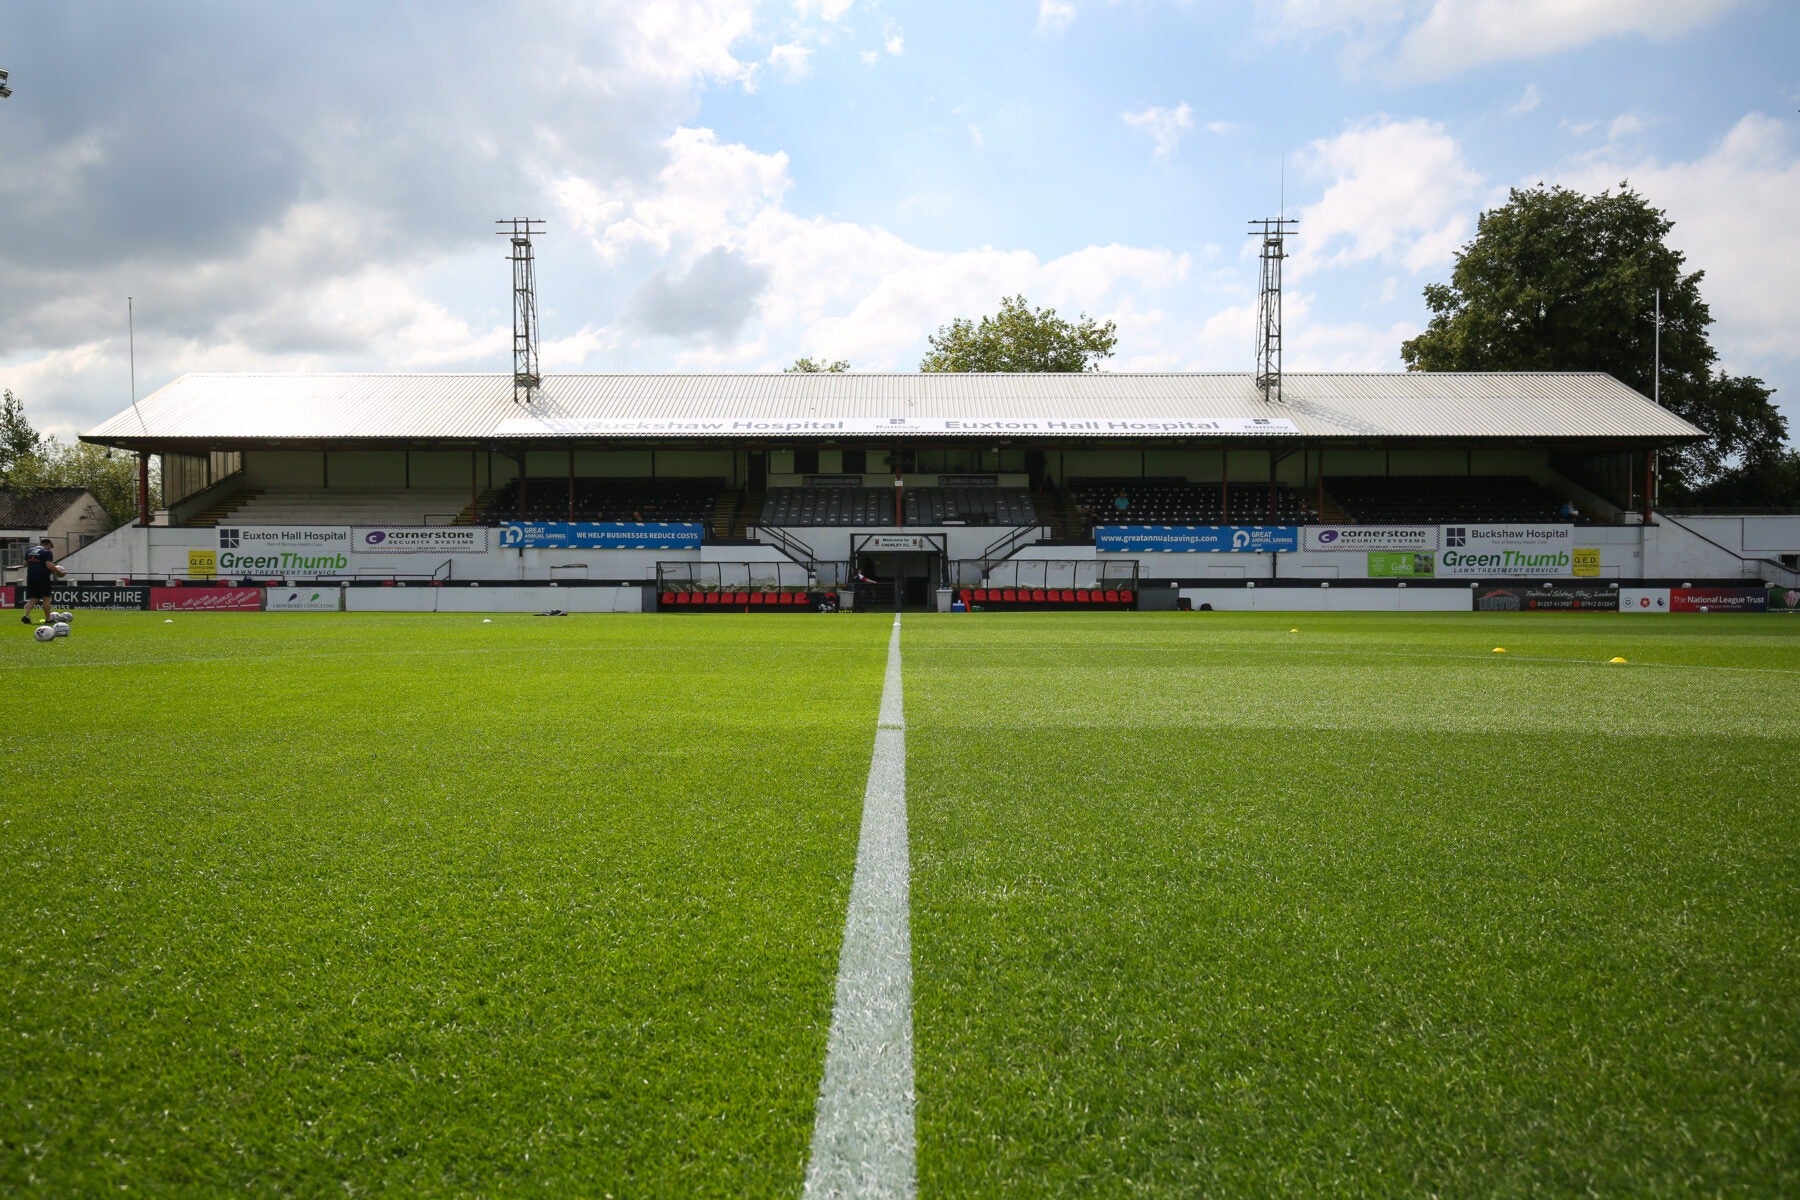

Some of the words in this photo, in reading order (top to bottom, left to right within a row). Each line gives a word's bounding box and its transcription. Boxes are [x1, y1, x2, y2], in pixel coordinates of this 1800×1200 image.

[584, 421, 723, 430] Buckshaw
[732, 421, 844, 431] Hospital
[945, 421, 1038, 429] Euxton
[1047, 421, 1099, 429] Hall
[1107, 421, 1220, 431] Hospital
[242, 531, 279, 540] Euxton
[281, 531, 301, 540] Hall
[304, 531, 347, 542] Hospital
[388, 531, 474, 539] cornerstone
[676, 532, 699, 540] COSTS
[1101, 533, 1218, 543] www.greatannualsavings.com
[1341, 529, 1426, 537] cornerstone
[1471, 529, 1524, 538] Buckshaw
[1526, 529, 1568, 540] Hospital
[219, 552, 348, 569] GreenThumb
[1443, 550, 1569, 567] GreenThumb
[81, 591, 111, 602] SKIP
[113, 591, 142, 602] HIRE
[1687, 596, 1718, 604] National
[1719, 596, 1745, 605] League
[1746, 596, 1765, 604] Trust
